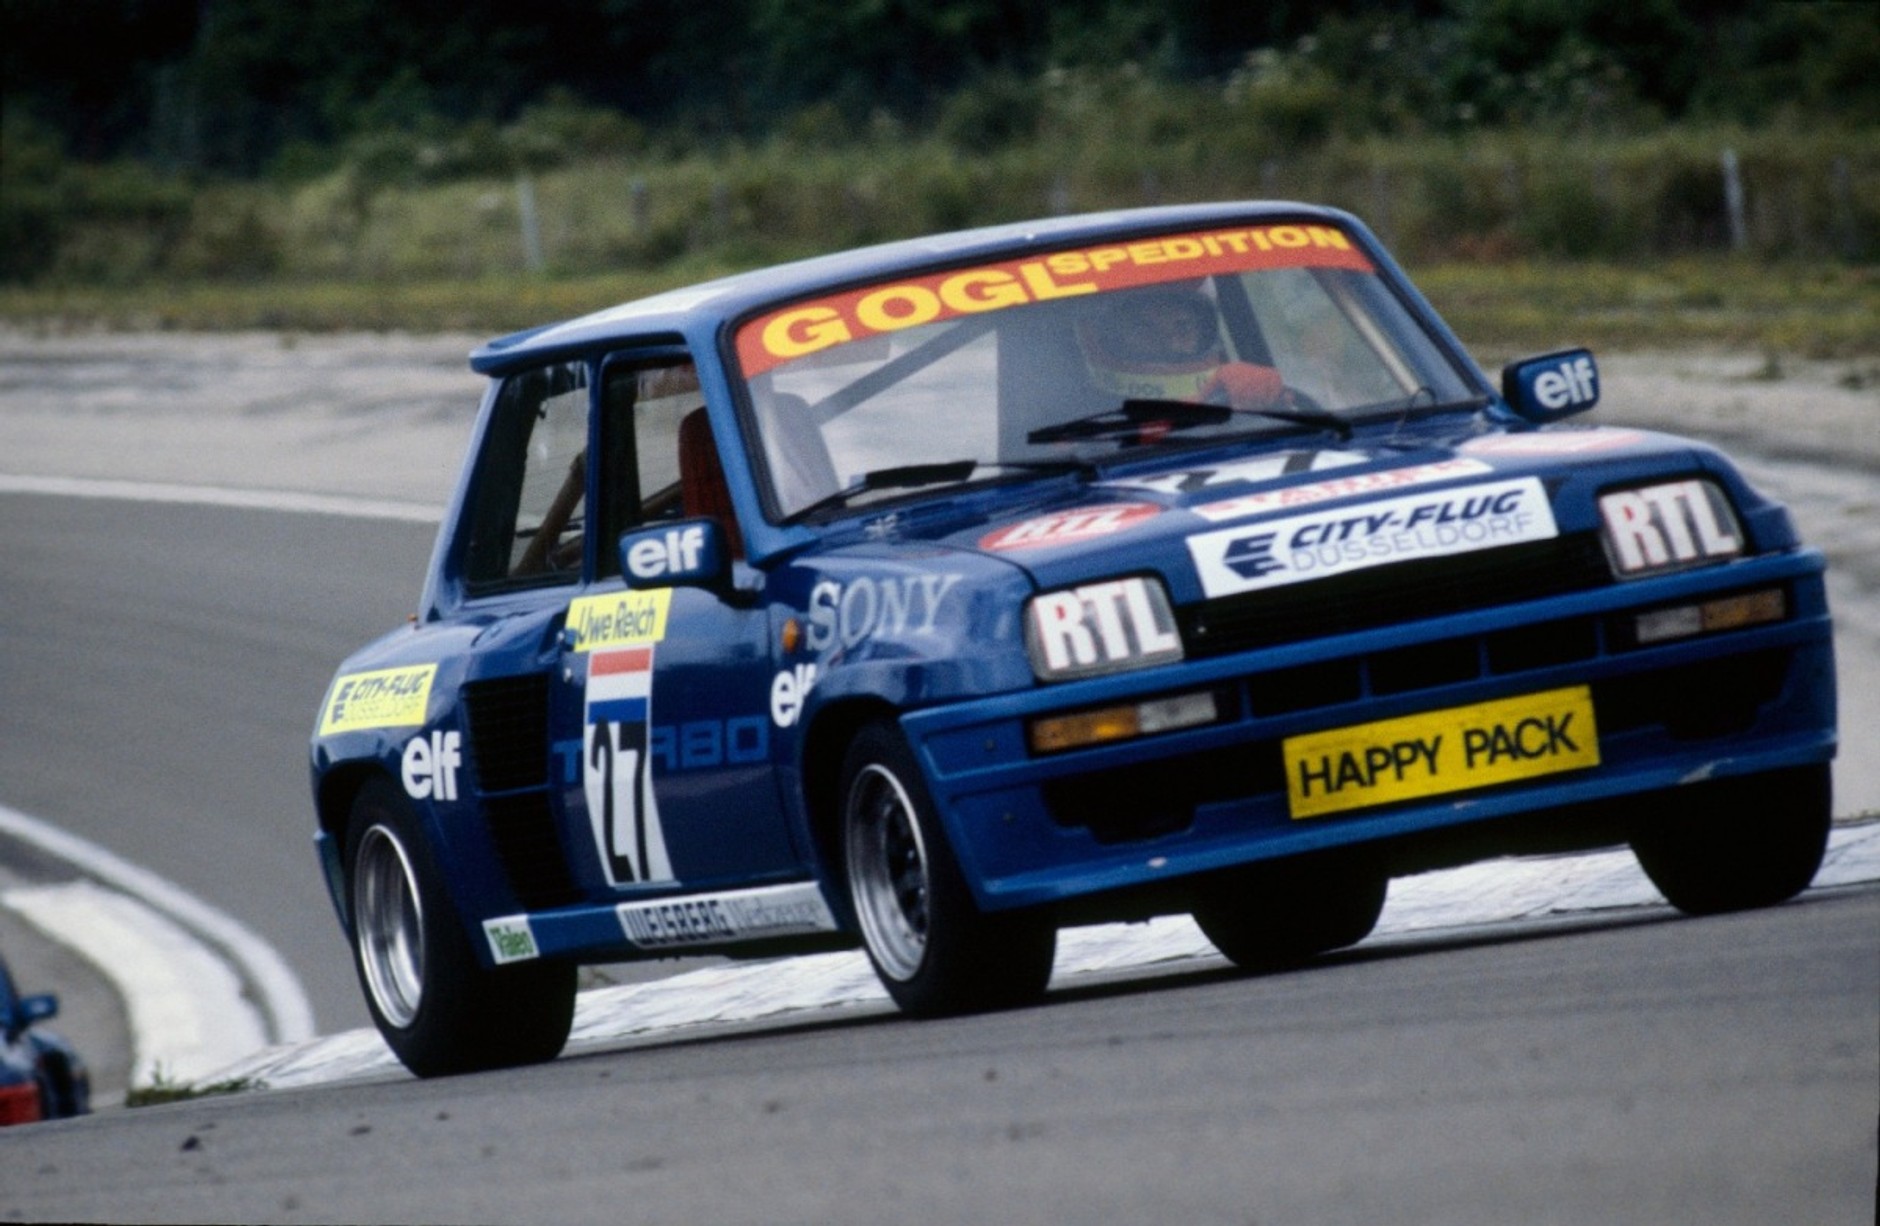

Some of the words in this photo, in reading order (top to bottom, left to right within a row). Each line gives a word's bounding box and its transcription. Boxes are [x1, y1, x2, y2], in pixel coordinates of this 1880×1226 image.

[762, 262, 1097, 359] GOGL
[1048, 225, 1351, 276] SPEDITION
[1534, 357, 1594, 408] elf
[627, 527, 705, 579] elf
[1289, 489, 1526, 549] CITY-FLUG
[1600, 478, 1739, 570] RTL
[577, 604, 612, 644] Uwe
[613, 597, 656, 640] Reich
[806, 573, 963, 651] SONY
[1031, 577, 1180, 672] RTL
[401, 730, 461, 800] elf
[1299, 735, 1443, 798] HAPPY
[1463, 712, 1580, 769] PACK
[591, 714, 651, 883] 27
